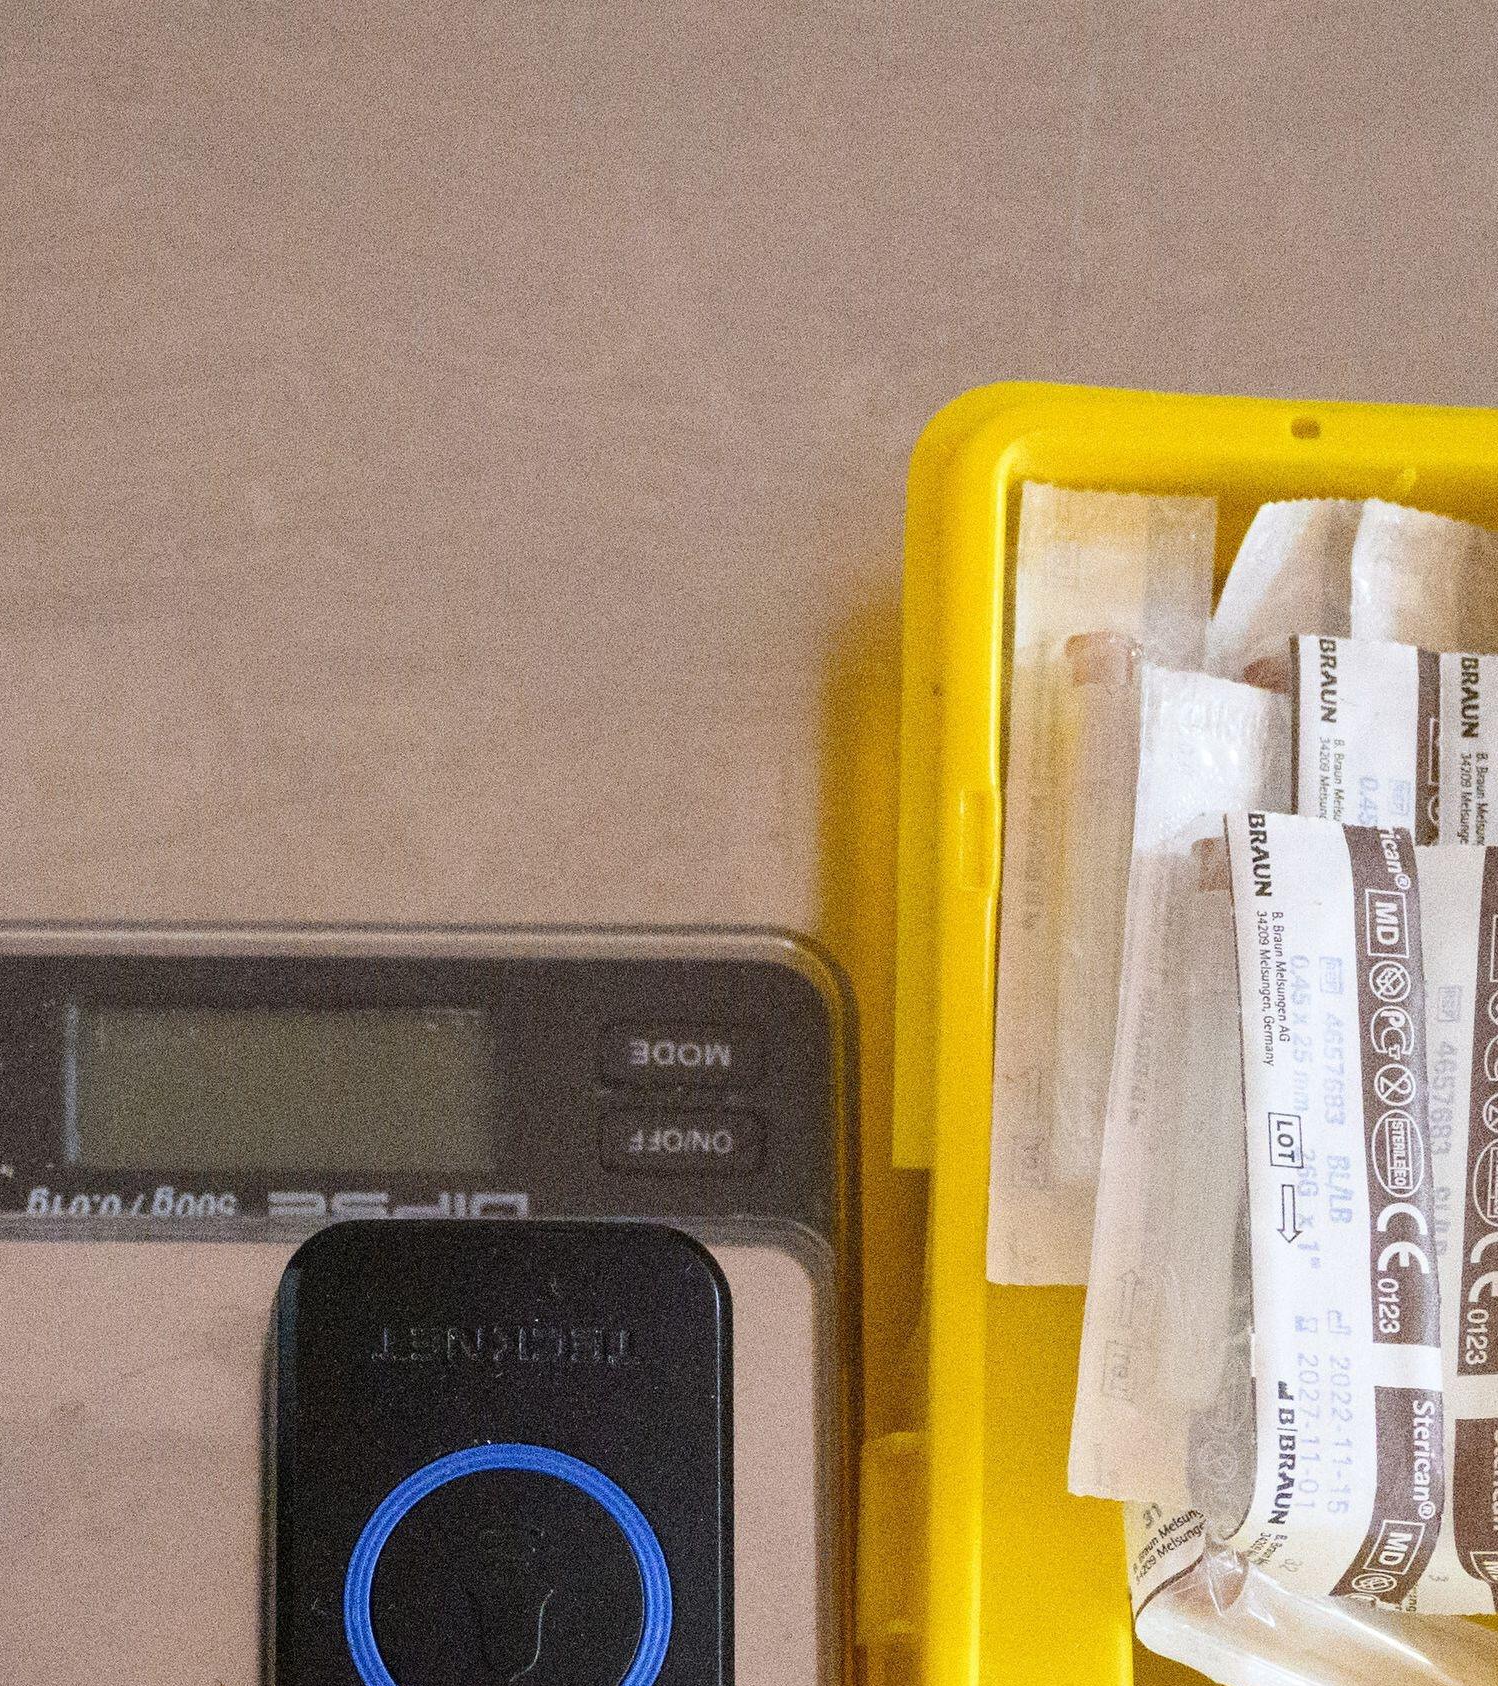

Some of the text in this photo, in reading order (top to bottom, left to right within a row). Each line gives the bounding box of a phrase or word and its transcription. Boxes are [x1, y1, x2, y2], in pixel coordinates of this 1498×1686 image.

[1319, 638, 1335, 722] BRAUN
[1460, 656, 1478, 738] BRAUN
[1247, 812, 1272, 898] BRAUN
[1255, 910, 1268, 945] 34209
[1374, 900, 1398, 945] MD
[1270, 924, 1290, 1042] Braun Melsungen AG
[629, 1040, 731, 1066] MODE
[1260, 1015, 1277, 1066] Germany
[627, 1129, 734, 1153] ON/OFF
[1276, 1119, 1297, 1163] LOT
[1376, 1277, 1399, 1334] 0123
[1465, 1308, 1488, 1366] 0123
[1292, 1352, 1322, 1511] 2027-11-01
[1323, 1355, 1355, 1515] 2022-11-15
[1267, 1434, 1296, 1524] BRAUN
[1378, 1530, 1411, 1567] MD
